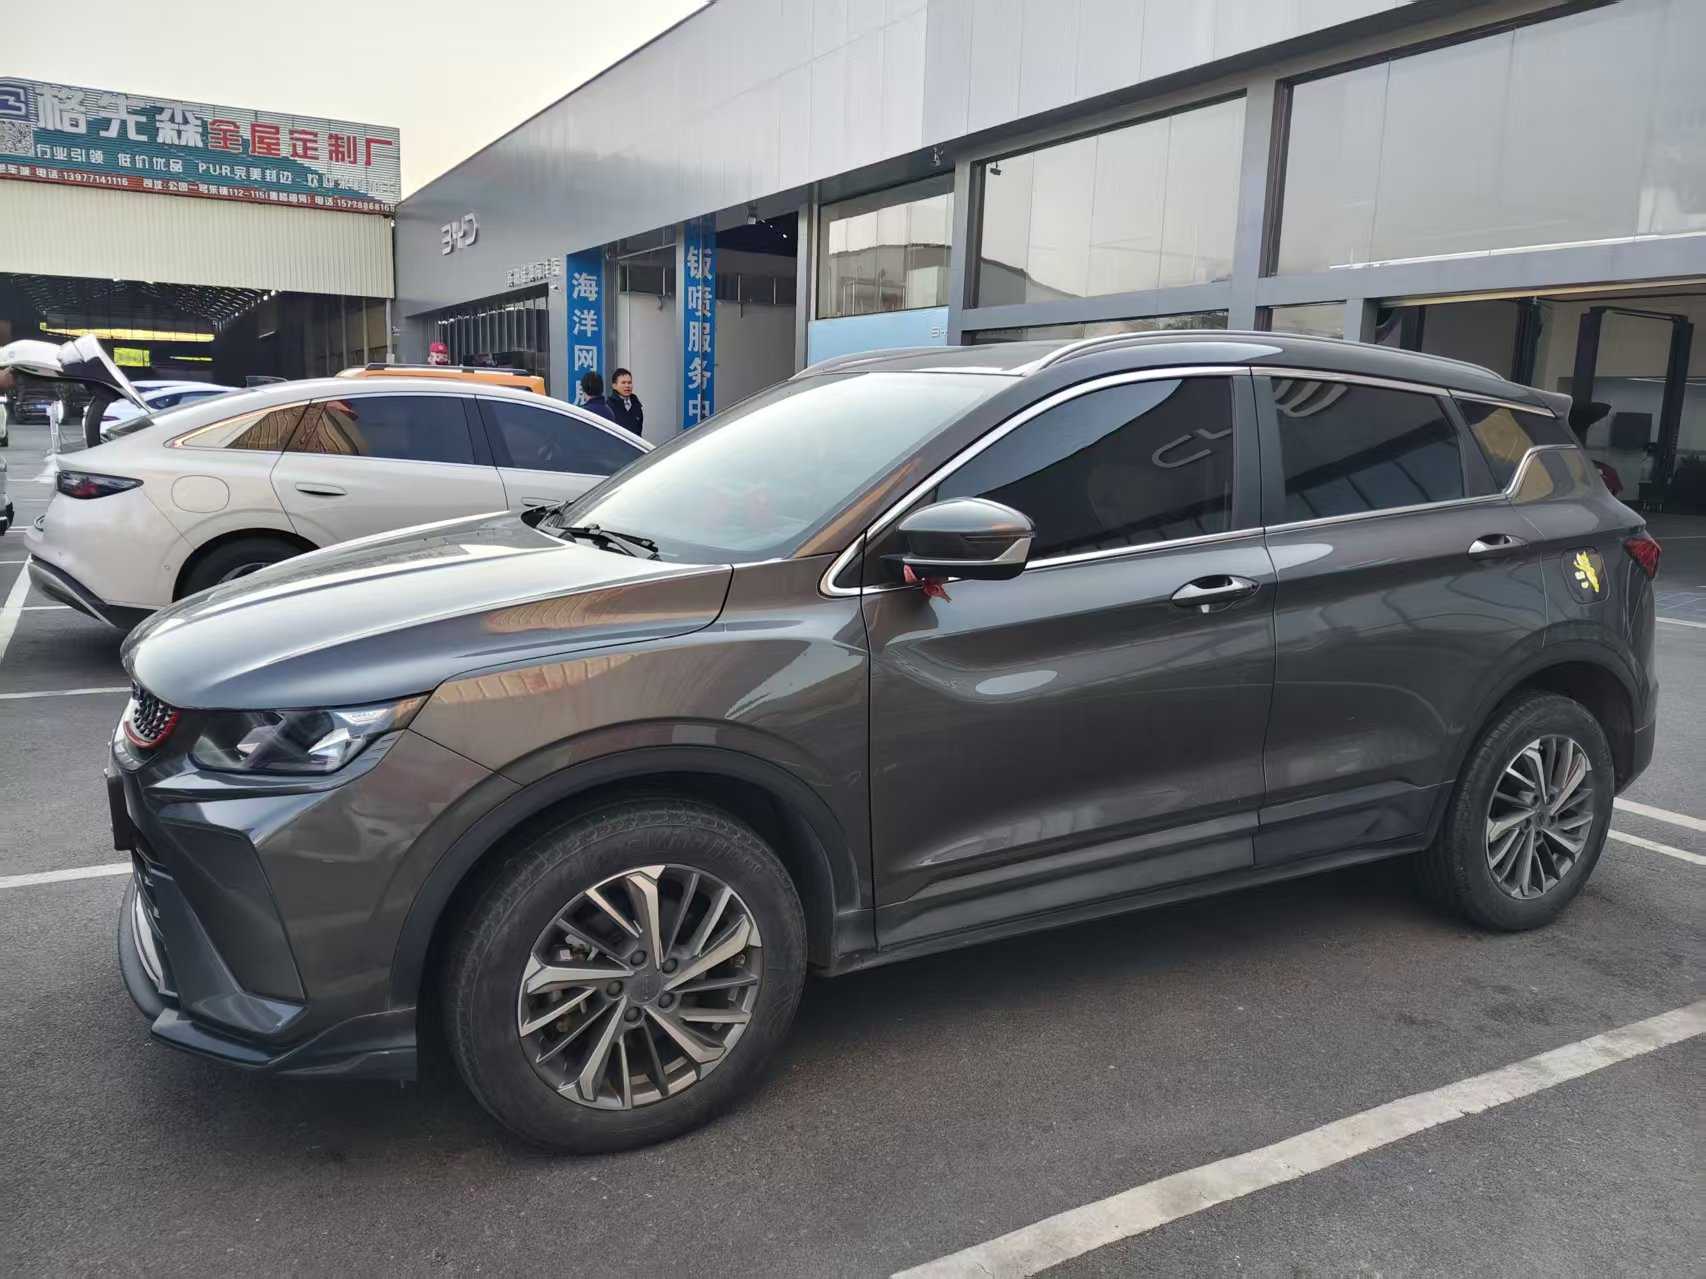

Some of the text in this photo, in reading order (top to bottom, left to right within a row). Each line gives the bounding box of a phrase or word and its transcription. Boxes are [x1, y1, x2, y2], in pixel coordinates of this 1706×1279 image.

[36, 143, 104, 164] 行业引领
[117, 153, 183, 173] 低价优品
[207, 119, 393, 167] 全屋定制厂
